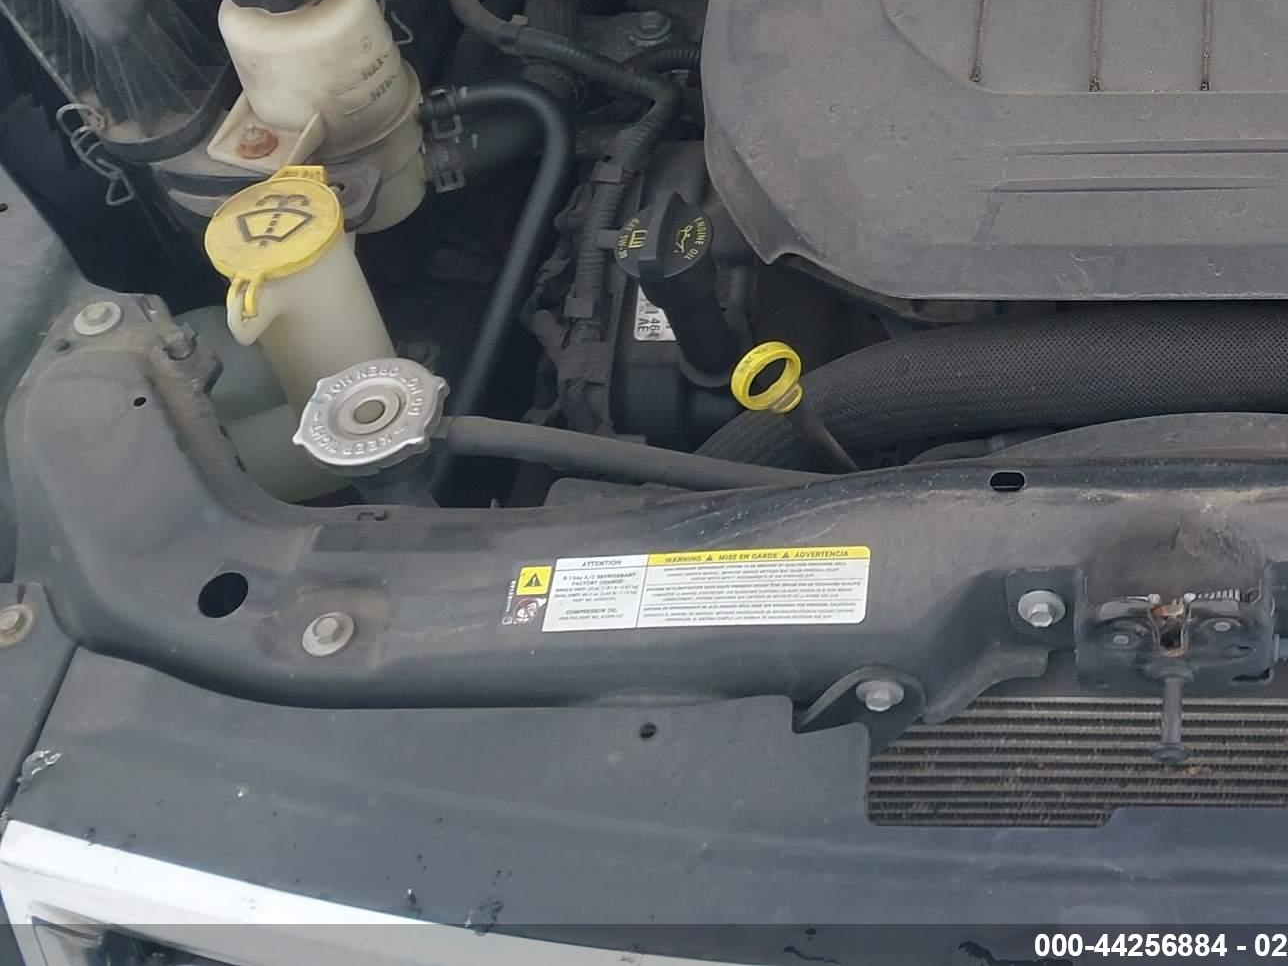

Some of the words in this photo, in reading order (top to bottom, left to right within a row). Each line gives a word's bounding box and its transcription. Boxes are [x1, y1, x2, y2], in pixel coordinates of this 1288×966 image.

[694, 216, 708, 246] ENGINE
[683, 247, 699, 260] OIL
[794, 550, 849, 558] ADVERTENCIA
